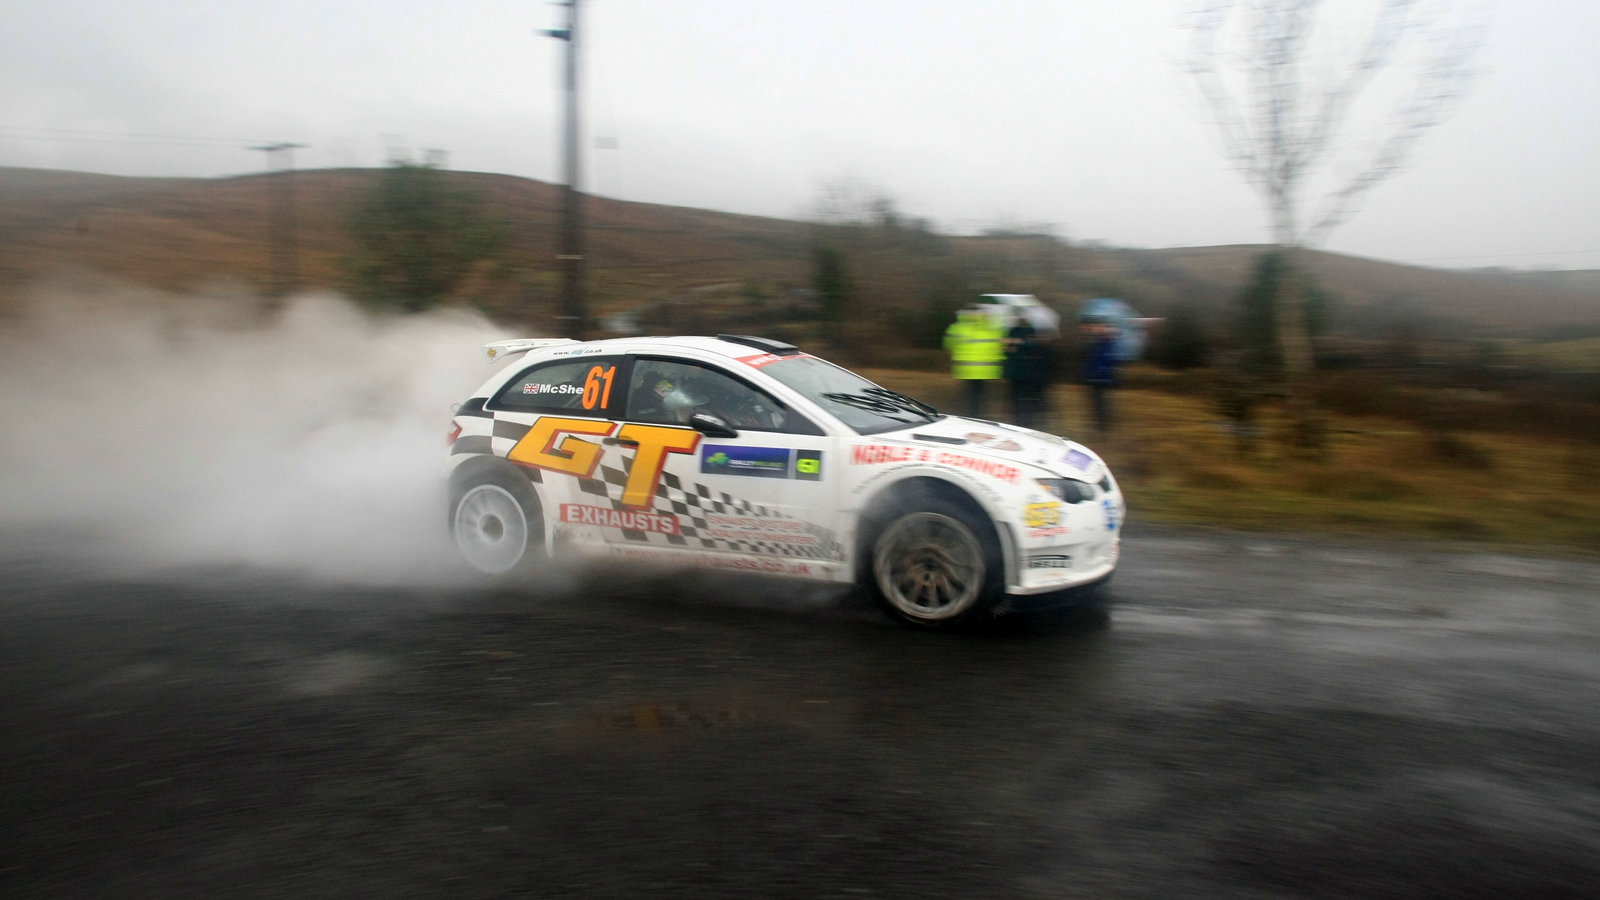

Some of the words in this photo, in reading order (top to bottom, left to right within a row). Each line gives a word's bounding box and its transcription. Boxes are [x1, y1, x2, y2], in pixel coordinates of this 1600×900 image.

[582, 365, 616, 410] 61
[507, 416, 702, 512] GT
[566, 504, 674, 533] EXHAUSTS
